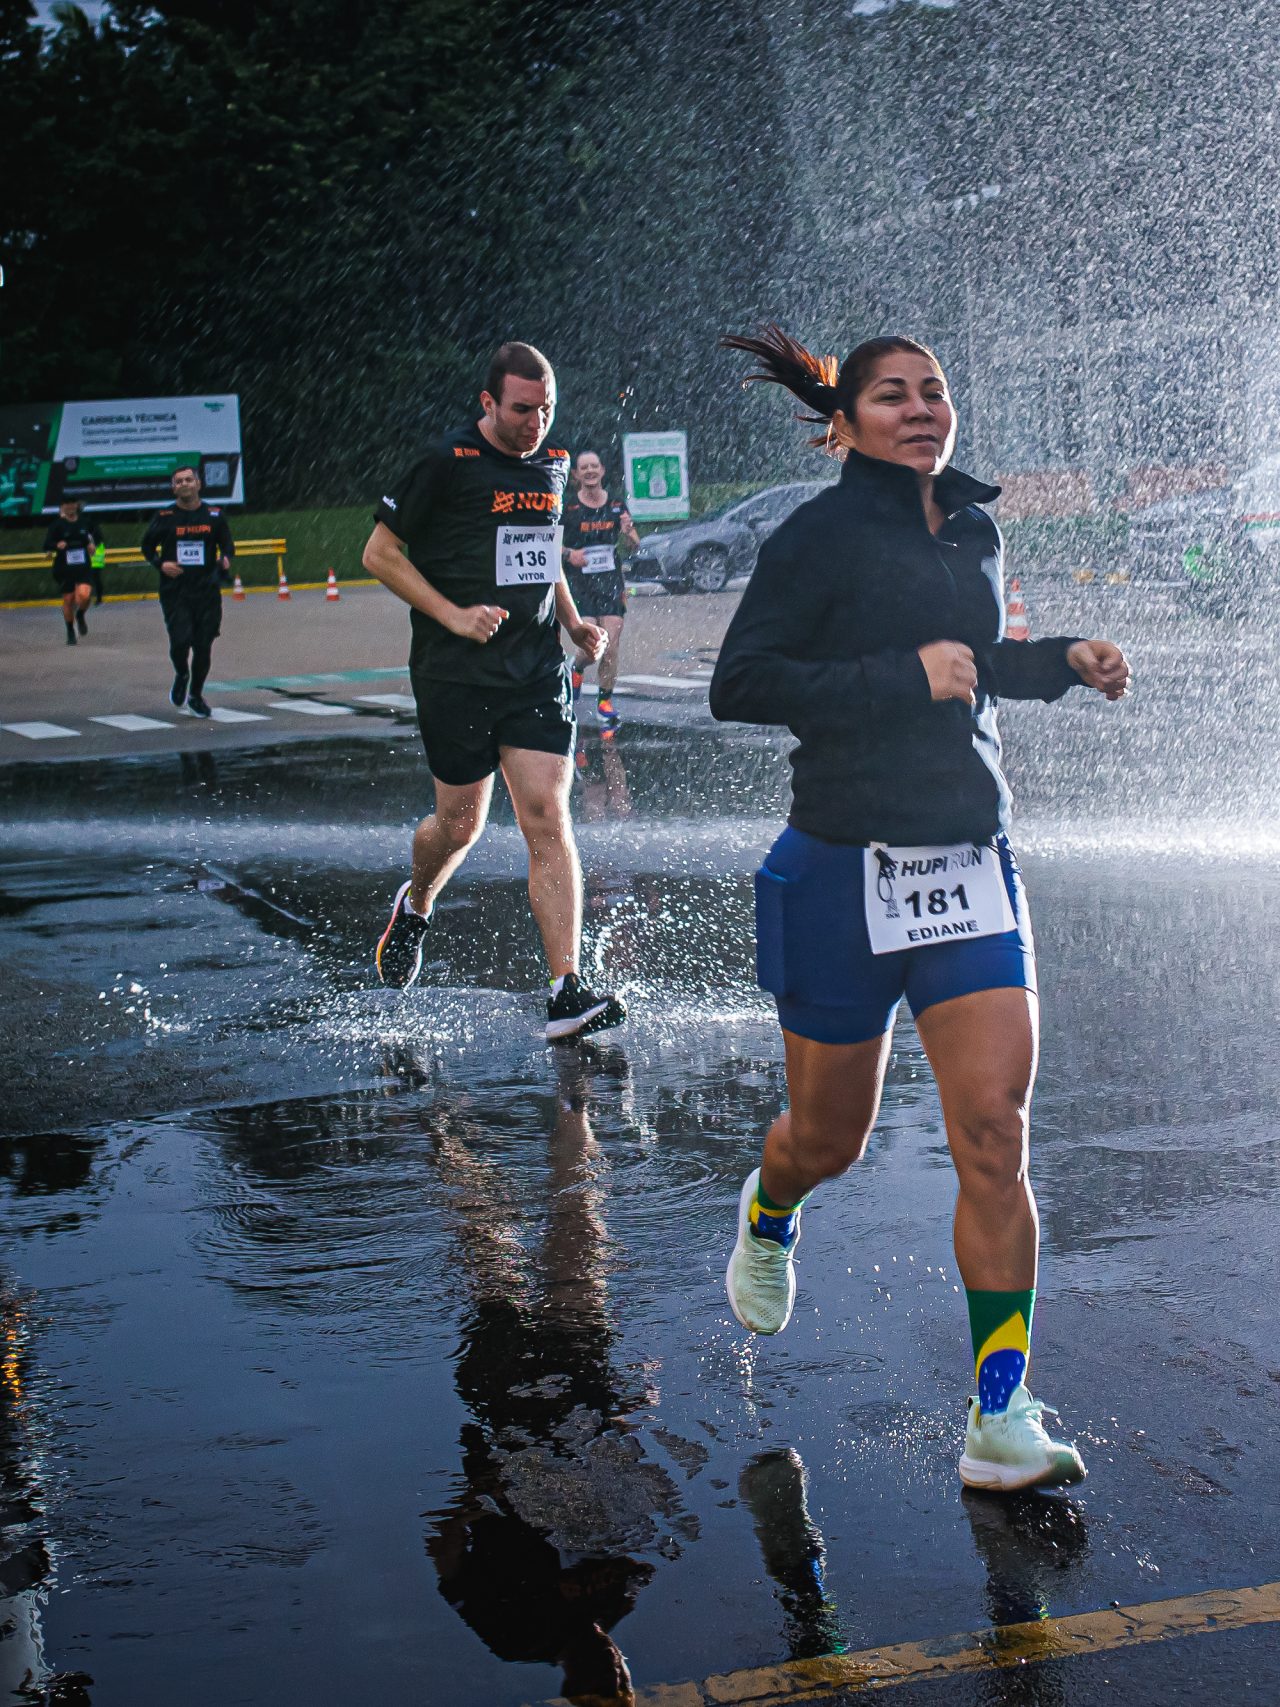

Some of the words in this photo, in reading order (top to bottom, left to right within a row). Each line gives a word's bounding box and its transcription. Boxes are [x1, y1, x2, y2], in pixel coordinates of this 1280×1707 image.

[515, 550, 547, 567] 136
[517, 572, 546, 581] VITOR
[901, 856, 949, 877] HUPI
[950, 849, 982, 871] RUN
[905, 883, 970, 918] 181
[907, 920, 979, 942] EDIANE
